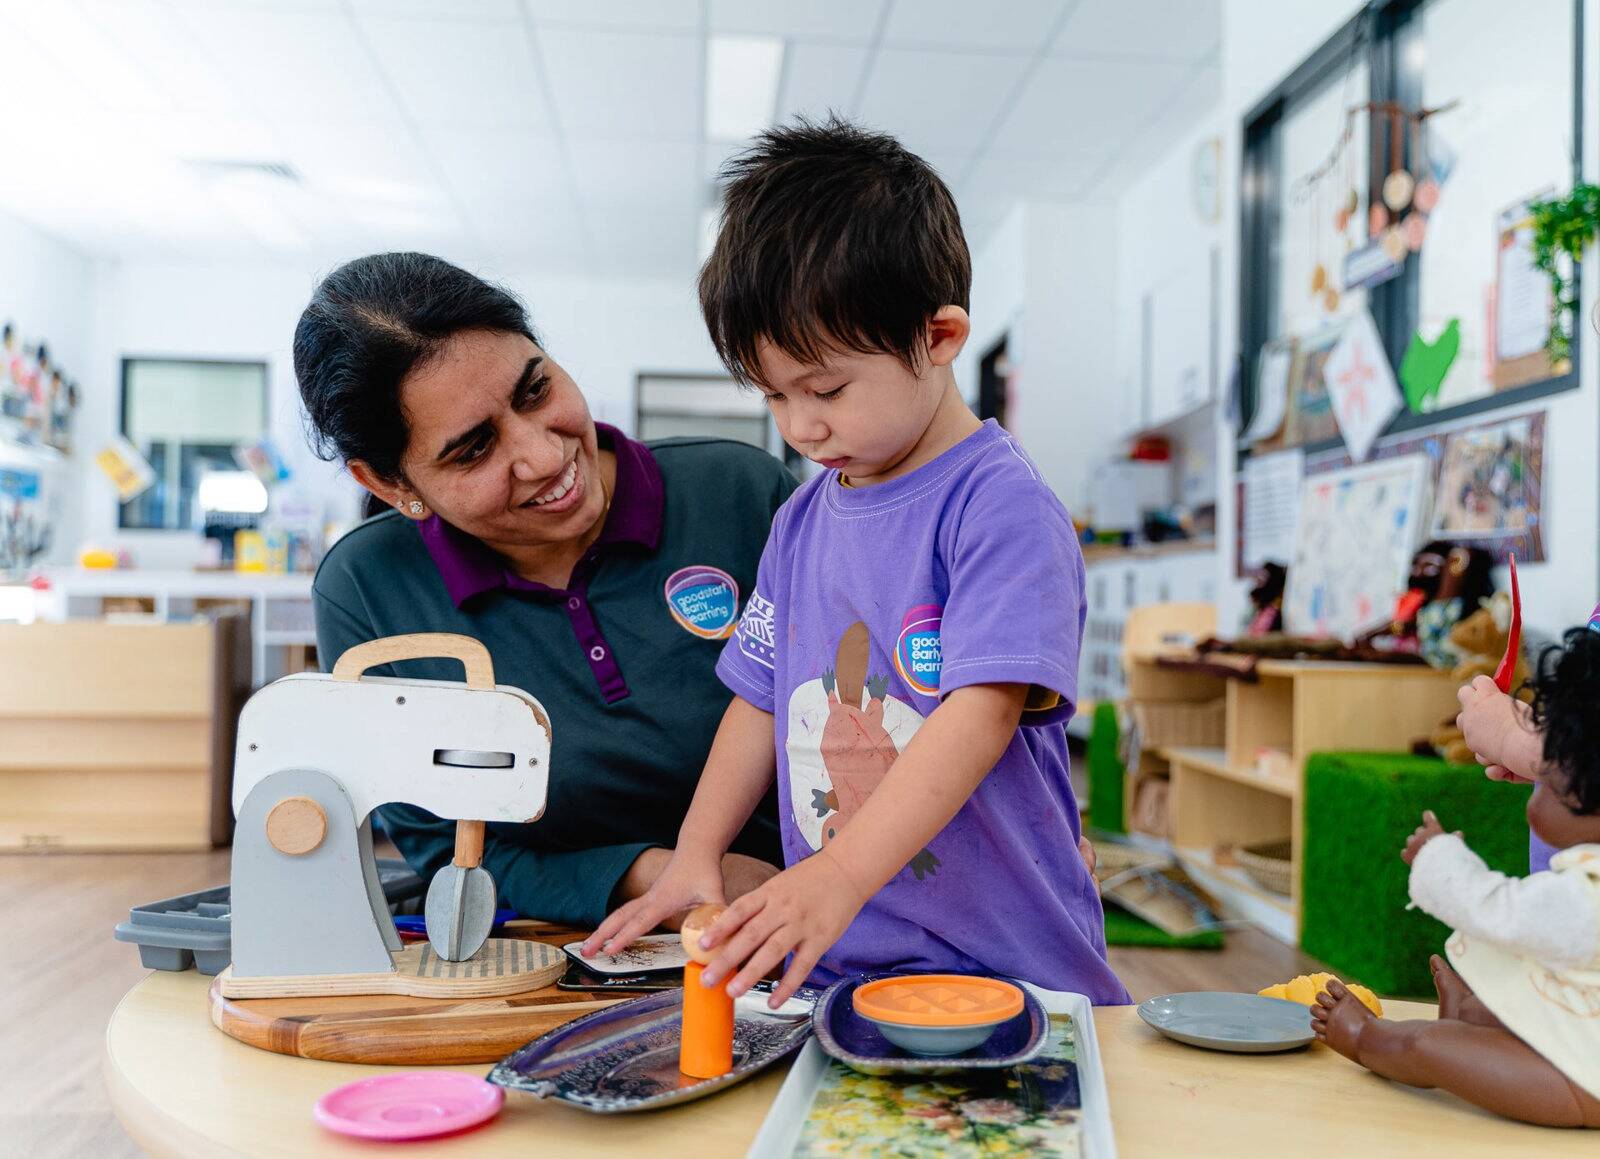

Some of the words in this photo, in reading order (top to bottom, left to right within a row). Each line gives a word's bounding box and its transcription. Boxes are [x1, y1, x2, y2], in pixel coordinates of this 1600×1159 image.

[677, 582, 727, 607] goodstart
[682, 601, 708, 615] early
[687, 606, 728, 623] learning
[912, 648, 941, 661] early
